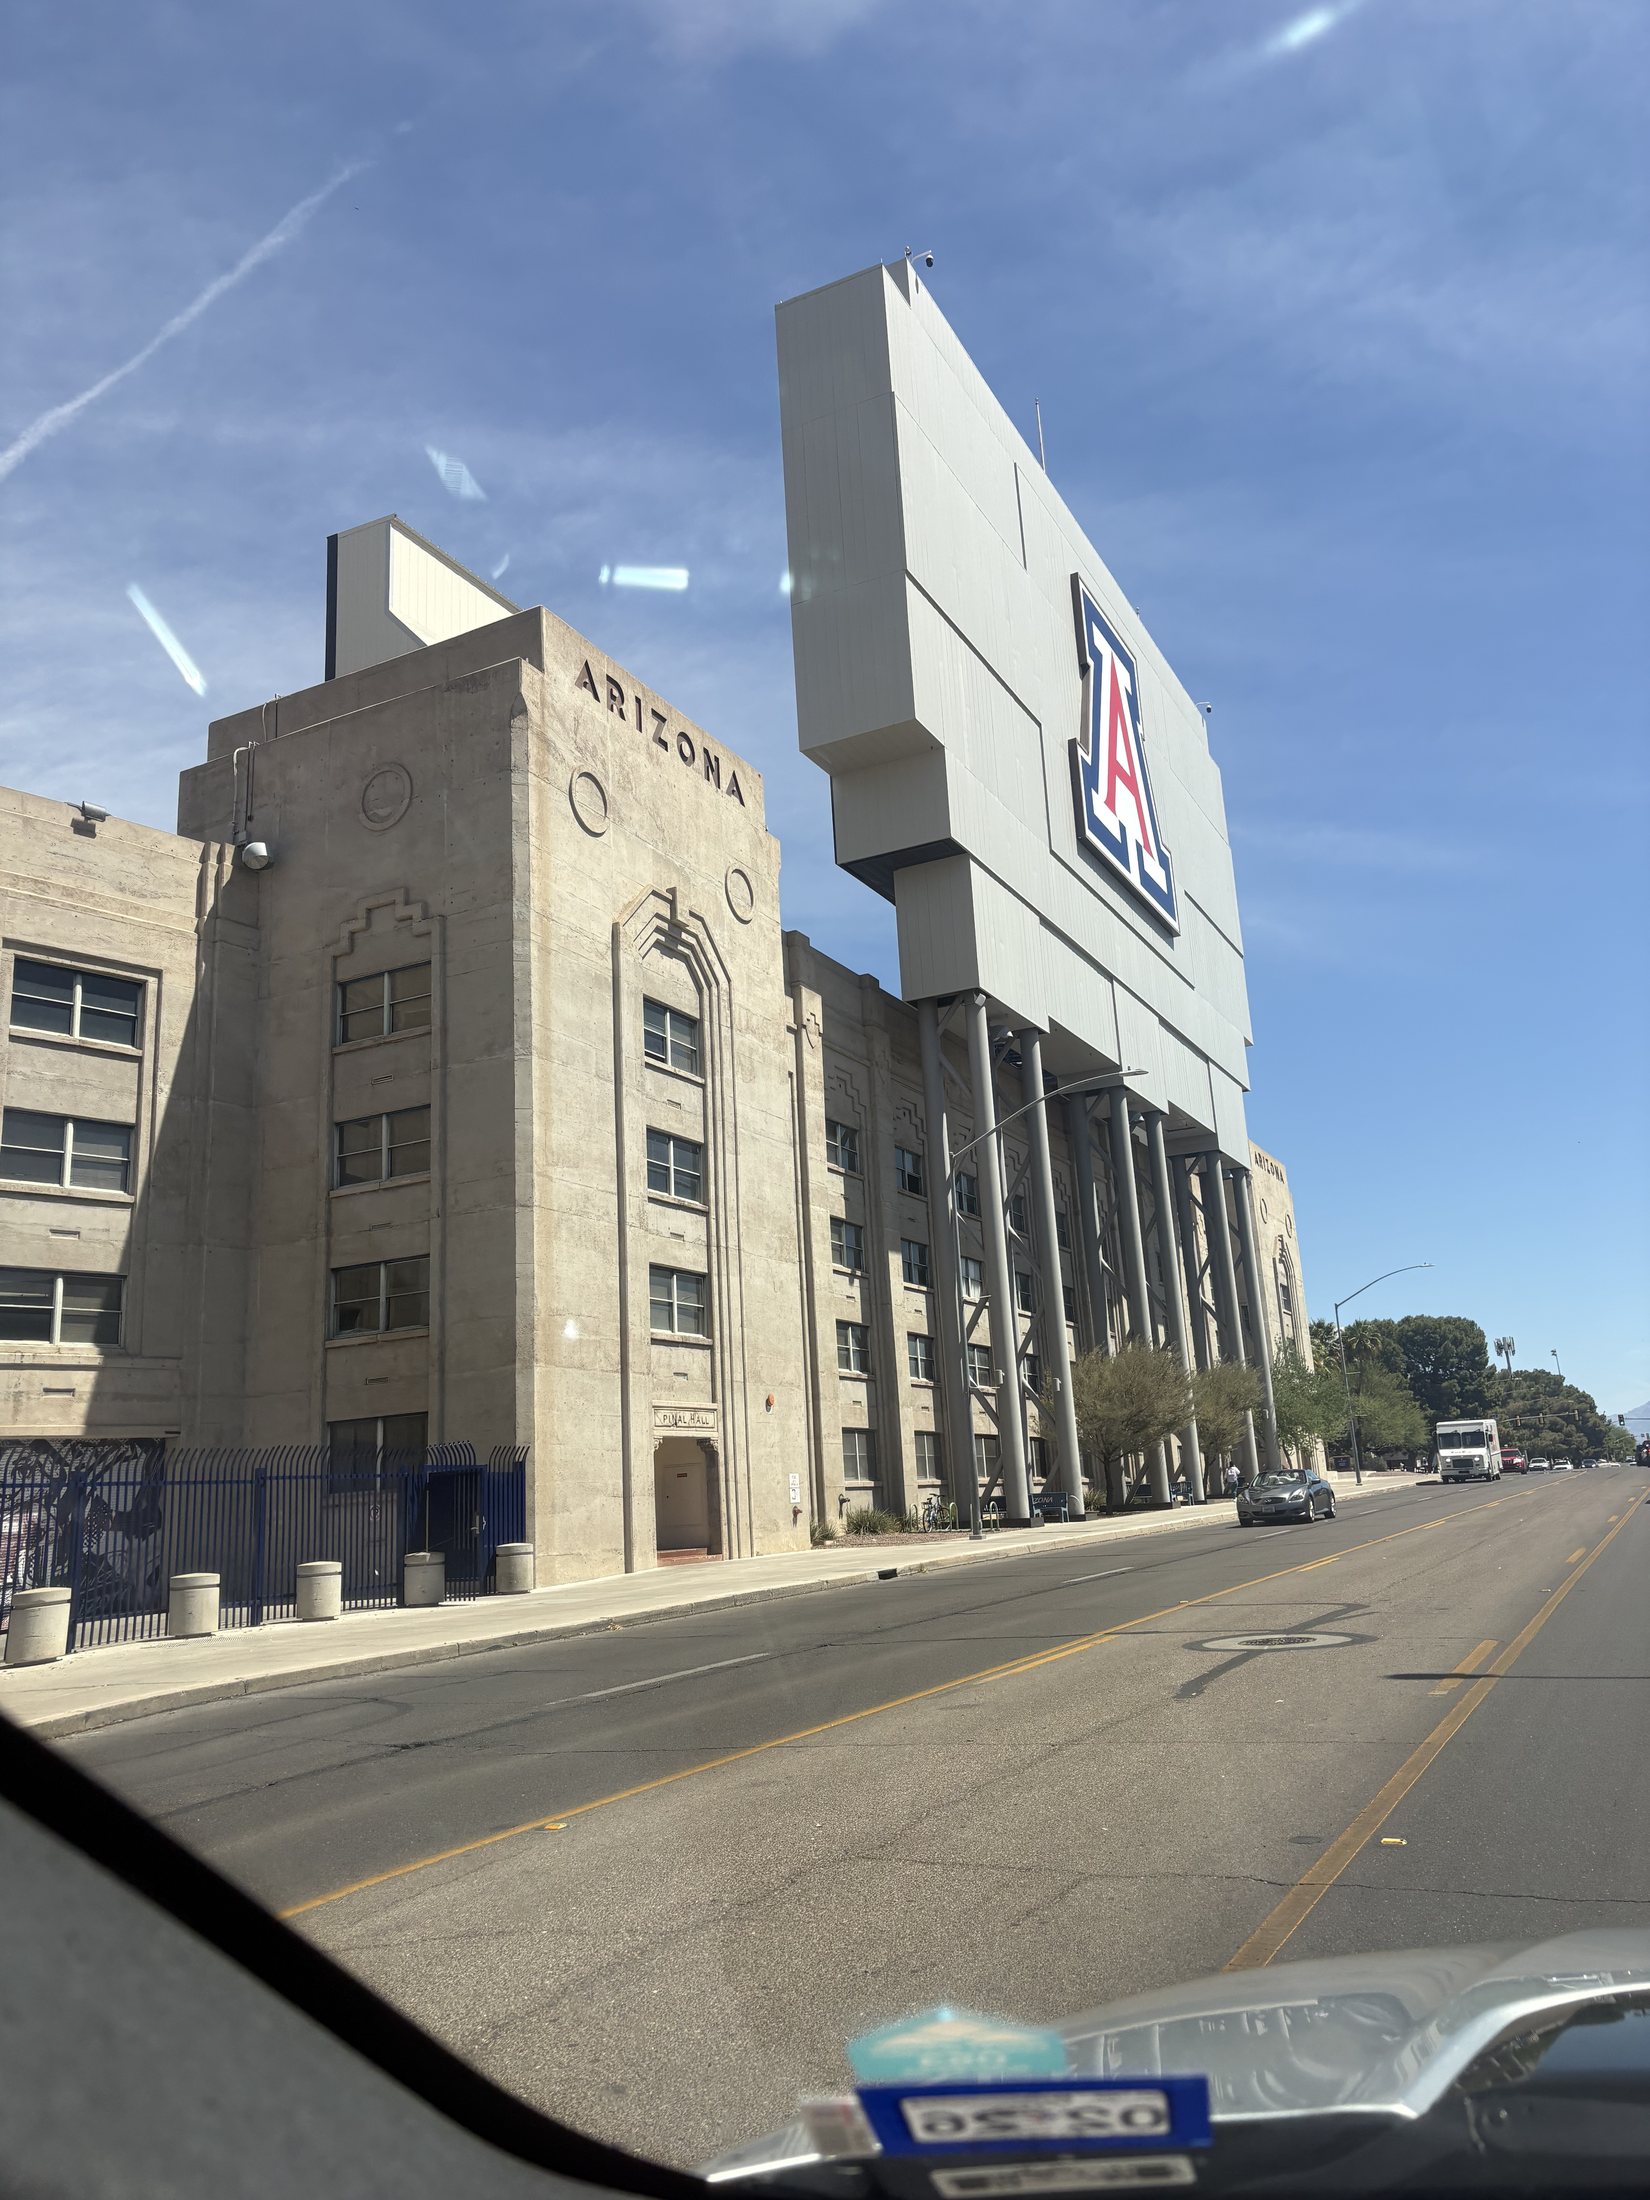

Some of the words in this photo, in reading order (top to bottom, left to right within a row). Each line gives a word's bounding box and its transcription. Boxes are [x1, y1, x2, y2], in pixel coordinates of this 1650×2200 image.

[574, 659, 745, 807] ARIZONA
[1069, 572, 1180, 937] A
[1254, 1151, 1285, 1184] ARIZONA
[689, 1413, 710, 1425] HALL
